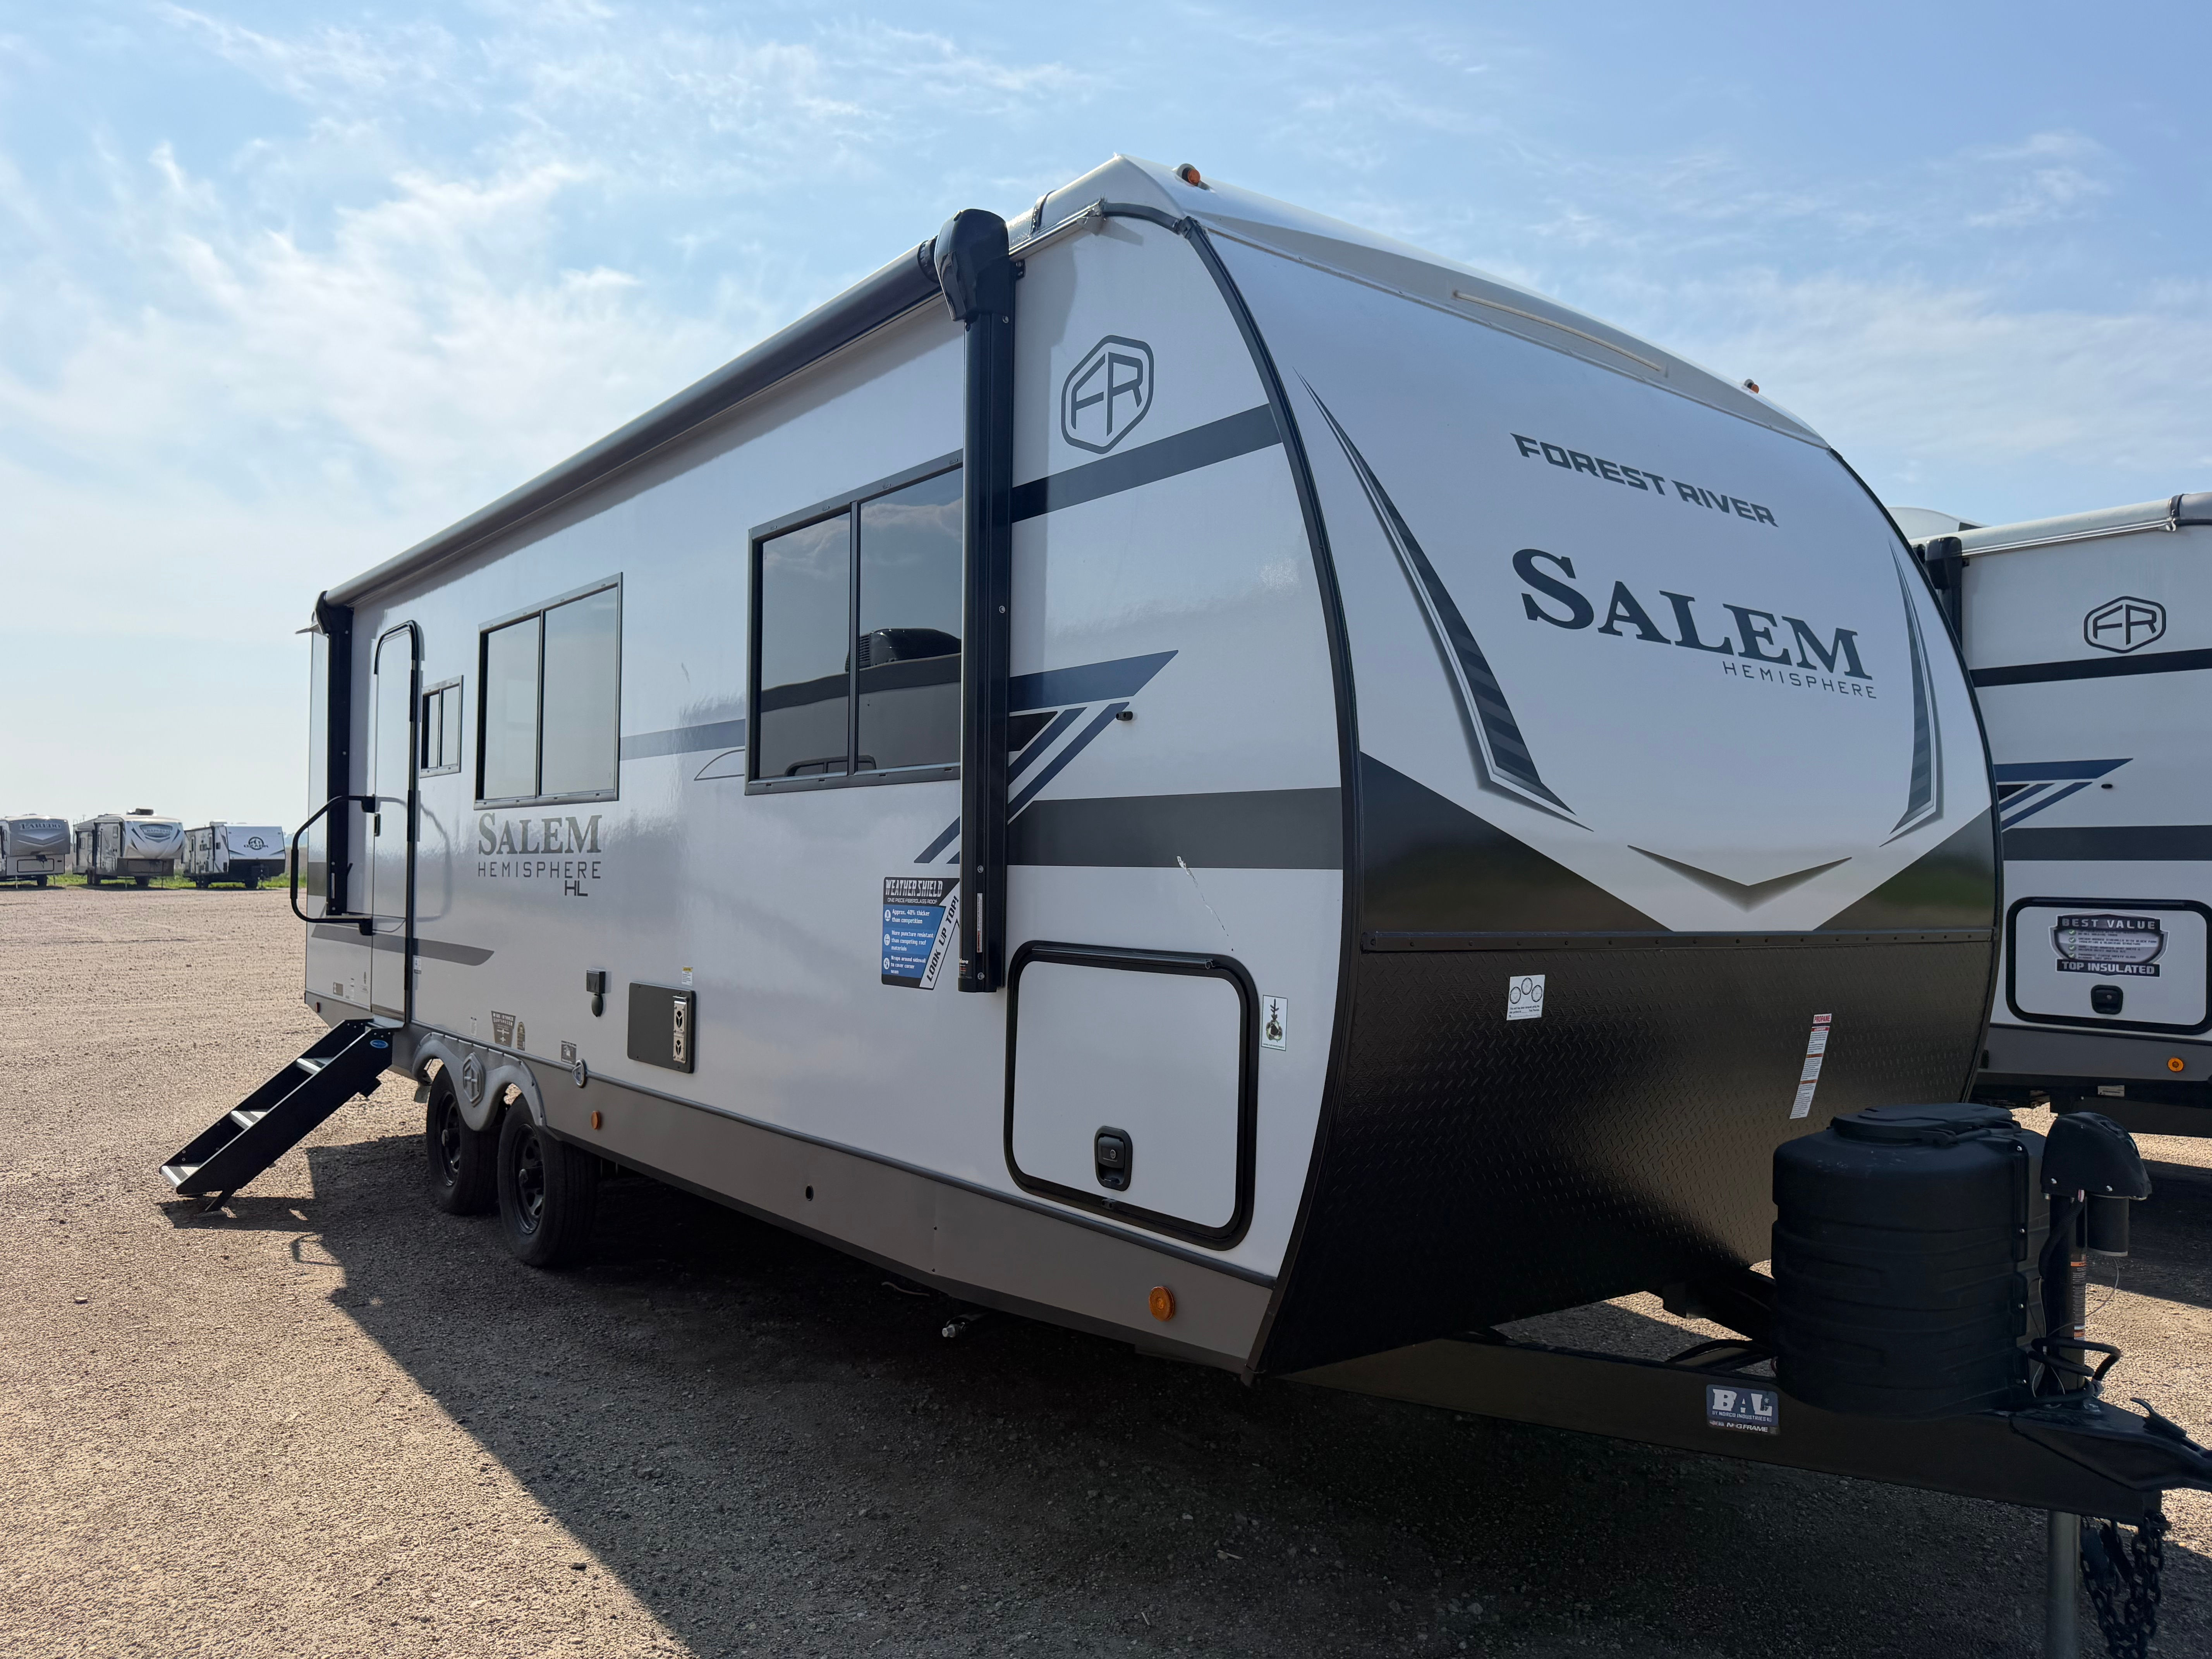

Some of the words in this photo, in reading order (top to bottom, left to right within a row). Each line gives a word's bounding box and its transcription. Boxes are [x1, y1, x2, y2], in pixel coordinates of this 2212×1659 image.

[1510, 432, 1666, 496] FOREST
[1671, 479, 1779, 528] RIVER
[1511, 548, 1873, 681] SALEM
[1722, 661, 1877, 700] HEMISPHERE
[478, 812, 603, 855] SALEM
[478, 861, 601, 879] HEMISPHERE
[564, 879, 588, 897] HL
[2062, 918, 2098, 927] BEST
[2107, 919, 2155, 929] VALUE
[926, 949, 941, 982] LOOK
[938, 927, 947, 946] UP
[945, 895, 959, 924] TOP!
[2061, 961, 2084, 970] TOP
[2088, 962, 2155, 974] INSULATED
[1737, 1413, 1766, 1421] INDUSTRIES
